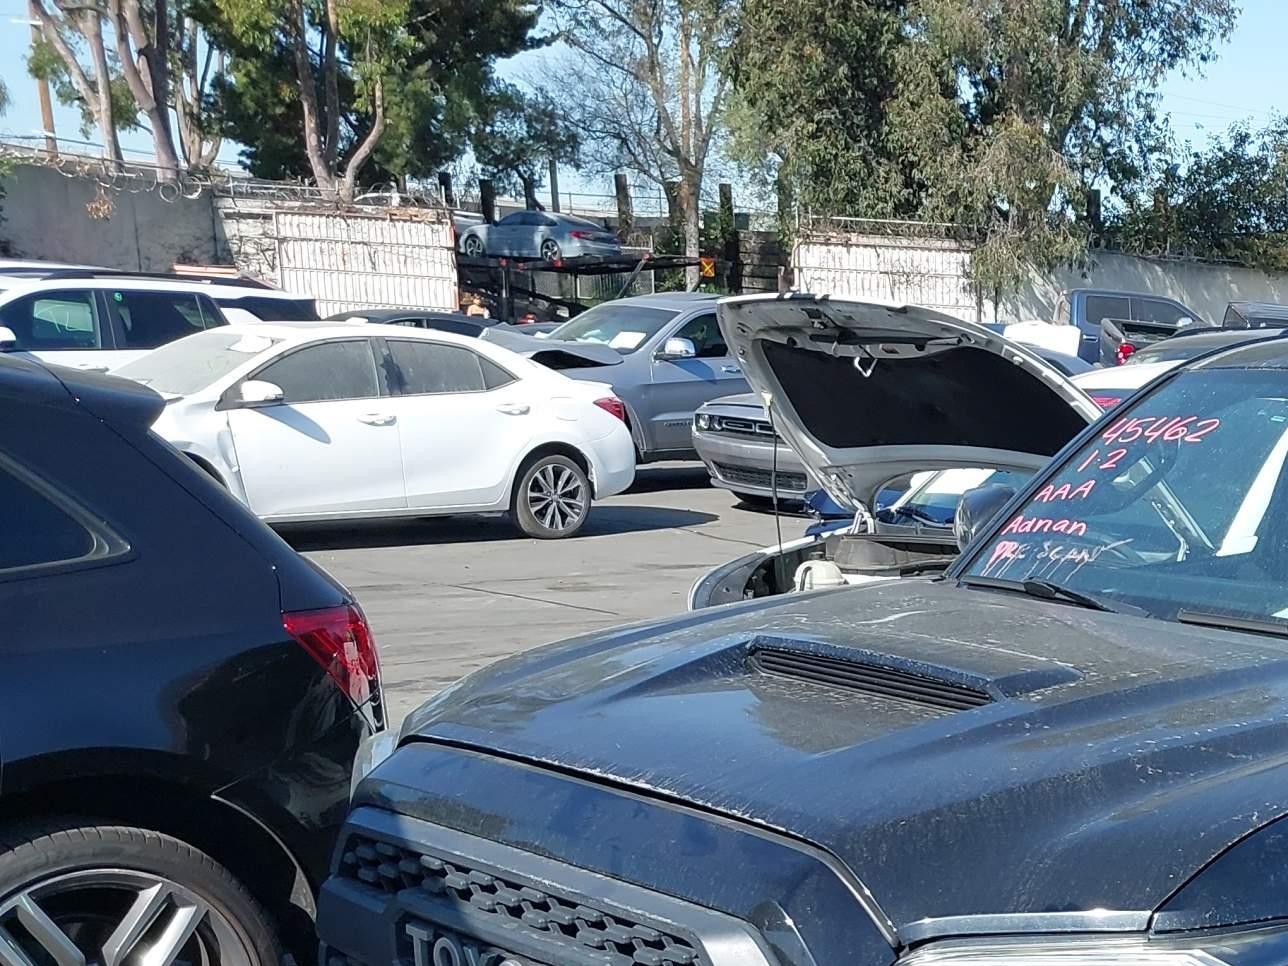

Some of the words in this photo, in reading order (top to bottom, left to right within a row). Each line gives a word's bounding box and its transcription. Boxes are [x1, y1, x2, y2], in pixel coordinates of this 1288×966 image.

[1102, 416, 1220, 446] 45462
[1034, 480, 1096, 503] AAA
[1001, 515, 1088, 536] Adnan
